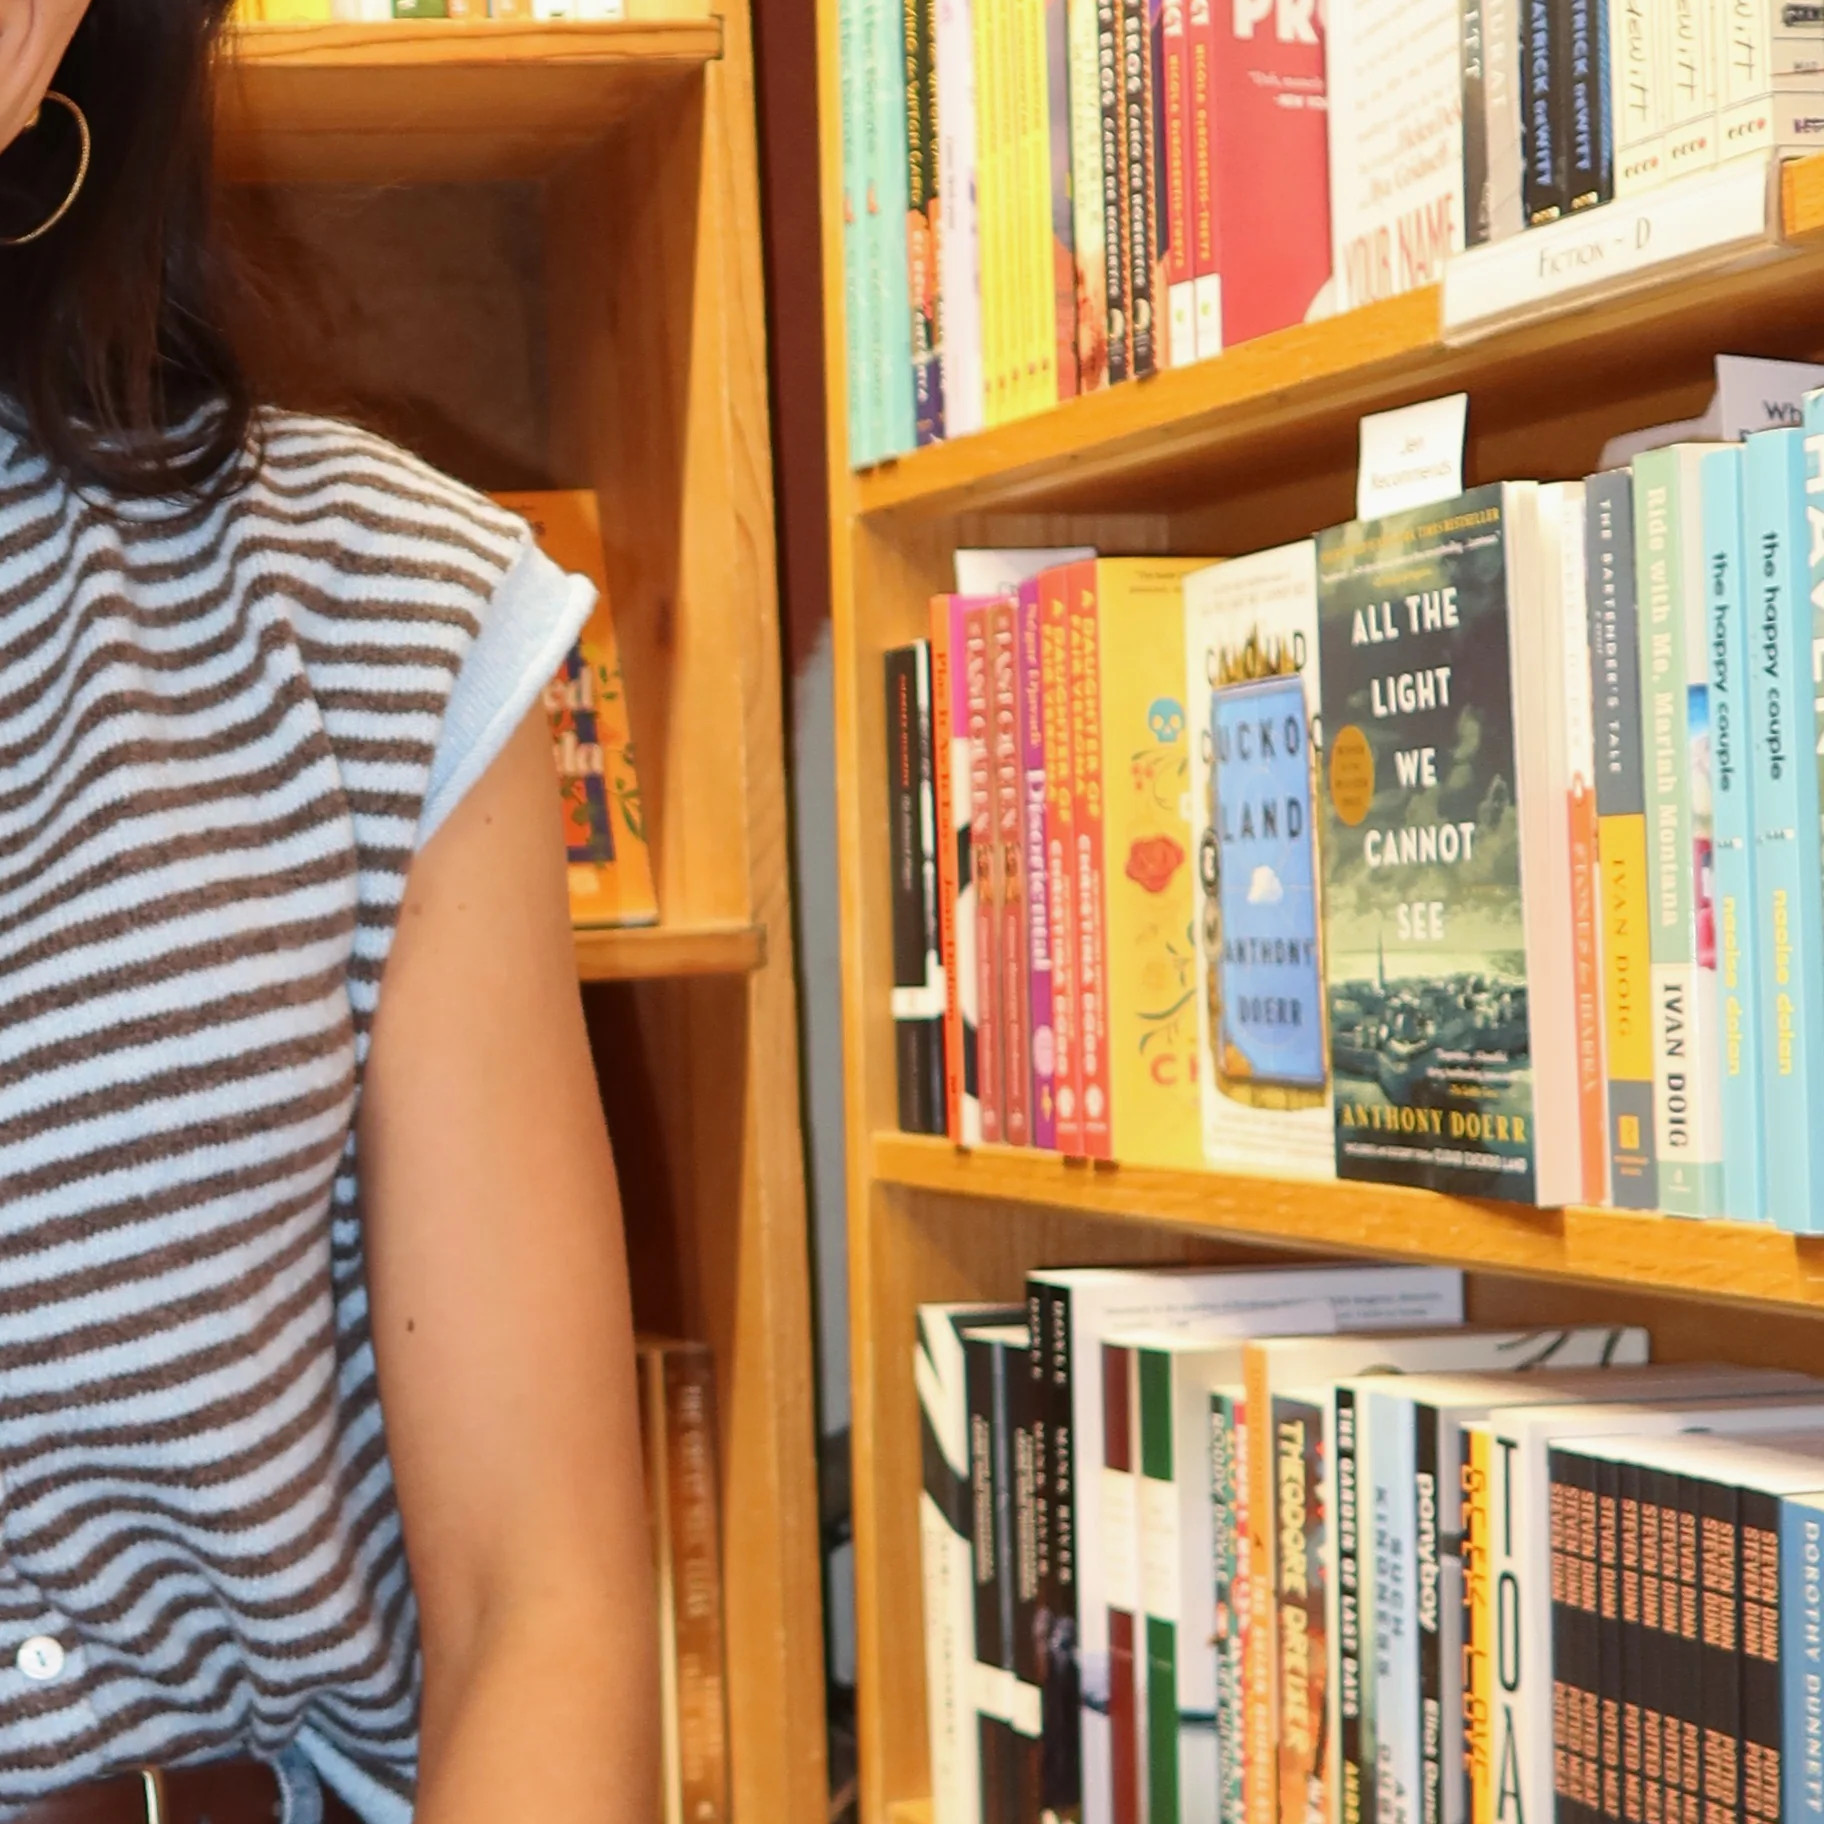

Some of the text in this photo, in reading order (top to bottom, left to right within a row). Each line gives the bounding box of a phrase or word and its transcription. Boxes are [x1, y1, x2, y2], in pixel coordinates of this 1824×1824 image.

[1351, 587, 1459, 646] ALL THE
[1599, 499, 1622, 772] THE BARTENDER'S TALE
[1711, 552, 1733, 792] the happy couple
[1762, 531, 1784, 780] the happy couple
[1373, 668, 1451, 717] LIGHT
[1647, 486, 1680, 926] Ride with Me, Mariah Montana
[1222, 796, 1303, 843] LAND
[1394, 748, 1437, 788] WE
[1364, 822, 1475, 867] CANNOT
[1223, 936, 1315, 966] ANTHONY
[1397, 901, 1444, 941] SEE
[1613, 859, 1632, 1036] IVAN DOIG
[1237, 995, 1303, 1026] DOERR
[1664, 984, 1688, 1147] IVAN DOIG
[1341, 1105, 1526, 1143] ANTHONY DOERR
[1340, 1458, 1354, 1552] GARDEN
[1416, 1473, 1438, 1632] ponyboy
[1581, 1490, 1596, 1612] STEVEN DUNN
[1600, 1496, 1617, 1619] STEVEN DUNN
[1621, 1498, 1638, 1623] STEVEN DUNN
[1641, 1503, 1659, 1628] STEVEN DUNN
[1342, 1596, 1356, 1651] LAST
[1376, 1487, 1390, 1676] KINDNESS
[1391, 1538, 1404, 1636] SUCH
[1661, 1507, 1678, 1634] STEVEN DUNN
[1343, 1657, 1359, 1718] DAYS
[1804, 1522, 1821, 1812] DOROTHY DUNNETT
